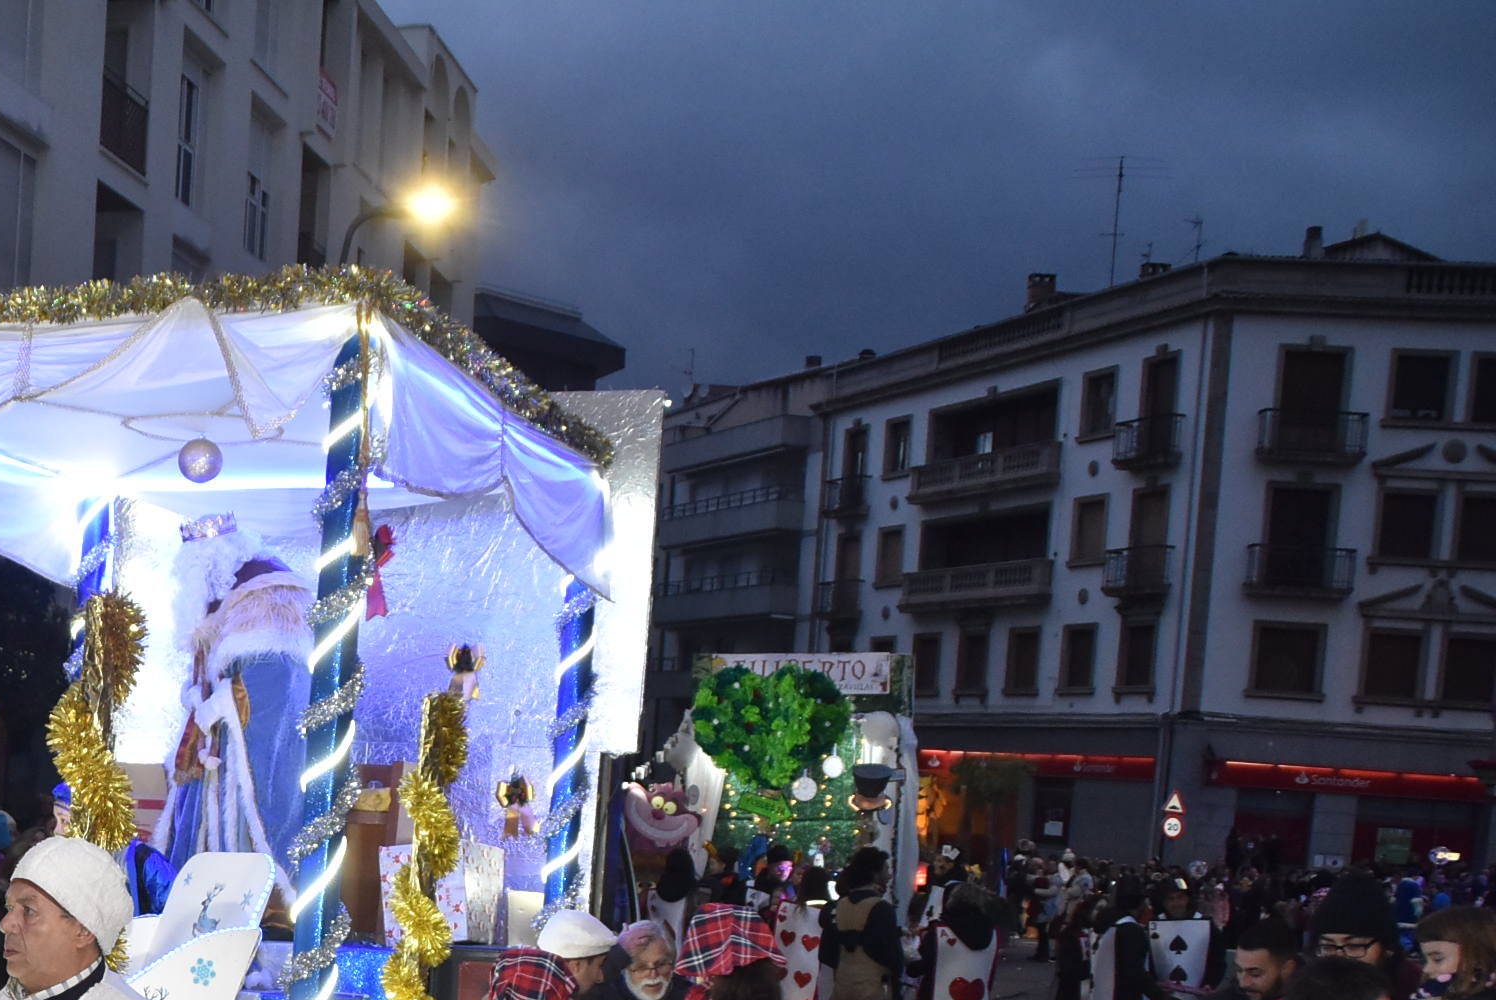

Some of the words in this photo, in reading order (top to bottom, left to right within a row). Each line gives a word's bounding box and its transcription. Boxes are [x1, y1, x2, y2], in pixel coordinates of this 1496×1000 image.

[1310, 773, 1371, 788] Santander
[1167, 822, 1179, 831] 20
[940, 929, 949, 939] A
